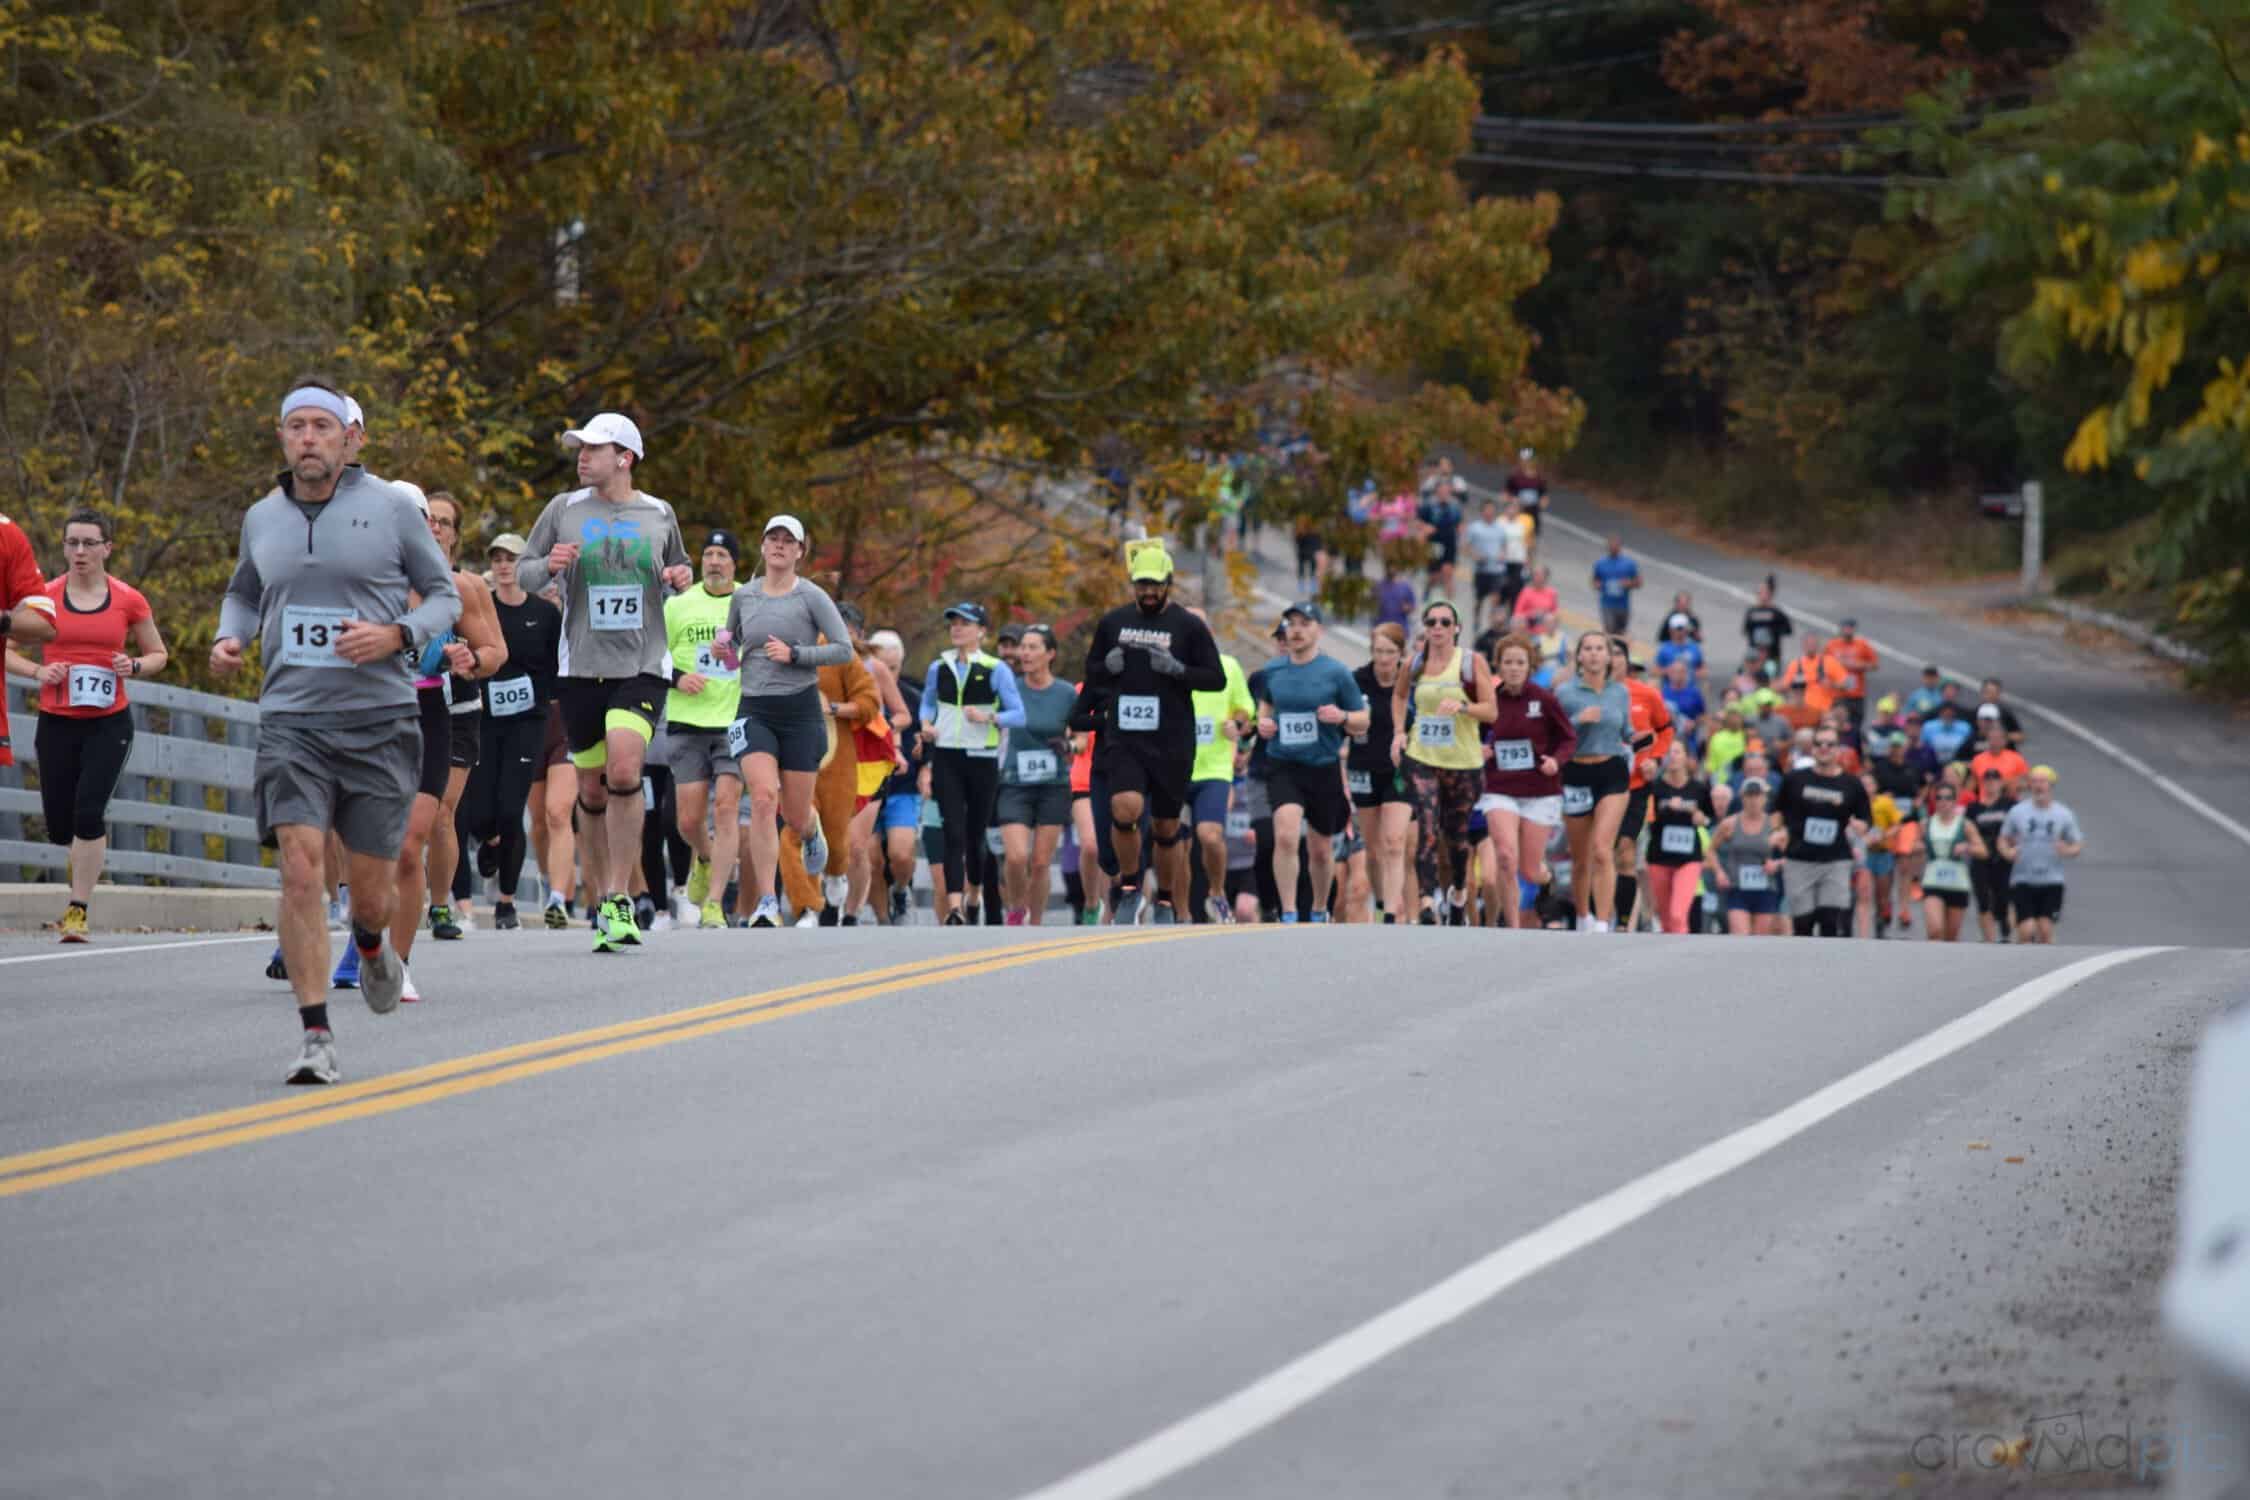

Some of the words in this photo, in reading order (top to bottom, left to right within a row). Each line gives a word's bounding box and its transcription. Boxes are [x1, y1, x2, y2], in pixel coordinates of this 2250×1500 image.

[596, 597, 637, 616] 175
[75, 677, 113, 695] 176
[494, 689, 529, 705] 305
[1122, 706, 1154, 719] 422
[1285, 722, 1313, 733] 160
[1422, 724, 1451, 736] 275
[1501, 747, 1529, 760] 793
[1028, 760, 1047, 771] 84
